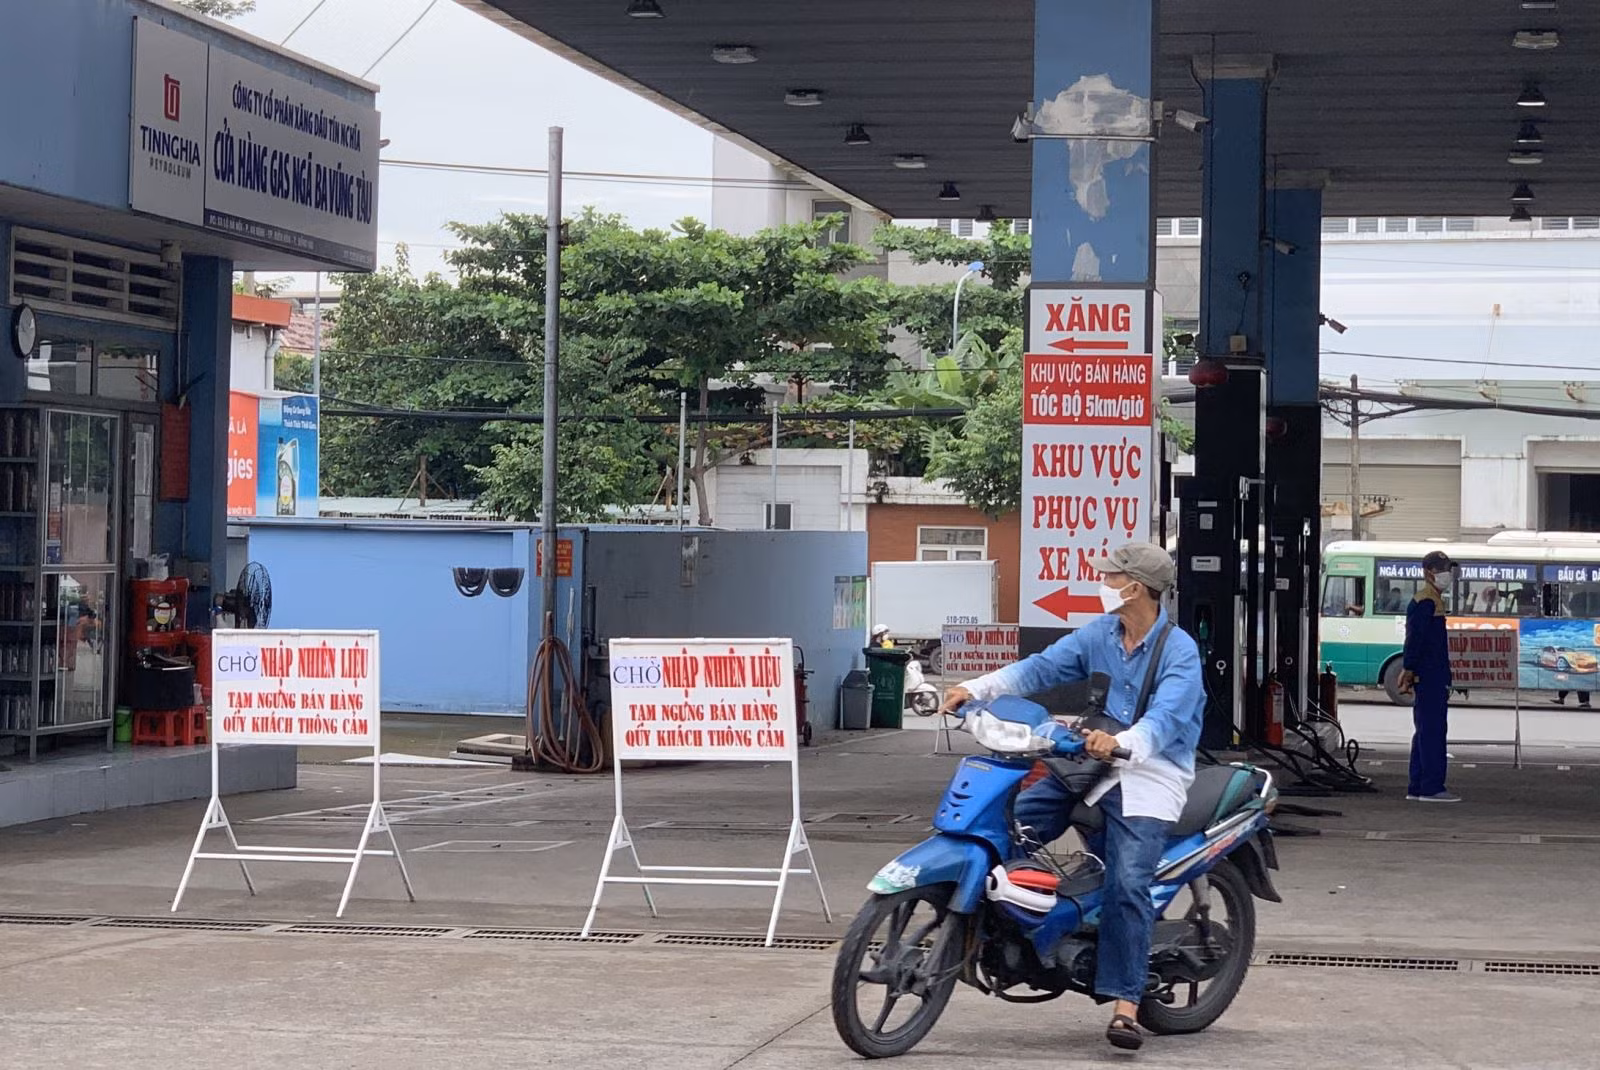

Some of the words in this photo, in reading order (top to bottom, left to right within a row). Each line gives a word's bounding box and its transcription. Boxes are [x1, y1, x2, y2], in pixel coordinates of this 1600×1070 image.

[232, 80, 252, 112] CÔNG
[254, 90, 264, 116] TY
[140, 125, 200, 168] TINNGHIA
[238, 131, 268, 193] HÀNG
[270, 150, 290, 200] GAS
[314, 164, 328, 212] BA
[1045, 296, 1132, 332] XĂNG
[1030, 363, 1056, 383] KHU
[1058, 360, 1082, 387] VỰC
[1085, 358, 1110, 384] BÁN
[1112, 358, 1146, 384] HÀNG
[1030, 386, 1058, 416] TỐC
[1061, 390, 1082, 422] ĐỘ
[1085, 394, 1145, 420] 5km/giờ
[228, 450, 253, 486] gies
[1032, 443, 1084, 478] KHU
[1090, 436, 1141, 486] VỰC
[1032, 495, 1098, 537] PHỤC
[1104, 496, 1139, 538] VỤ
[1038, 547, 1070, 580] XE
[1398, 568, 1403, 578] 4
[1406, 566, 1424, 578] VŨN
[1516, 568, 1528, 580] AN
[218, 651, 258, 672] CHỜ
[260, 640, 294, 687] NHẬP
[298, 640, 336, 678] NHIÊN
[340, 640, 368, 688] LIỆU
[613, 661, 661, 684] CHỜ
[662, 647, 699, 698] NHẬP
[703, 647, 746, 688] NHIÊN
[750, 647, 781, 698] LIỆU
[301, 688, 325, 710] BÁN
[330, 689, 363, 710] HÀNG
[710, 698, 736, 721] BÁN
[742, 698, 778, 721] HÀNG
[252, 711, 293, 734] KHÁCH
[298, 713, 338, 734] THÔNG
[342, 711, 368, 735] CẢM
[656, 724, 703, 747] KHÁCH
[708, 725, 752, 747] THÔNG
[757, 722, 785, 747] CẢM
